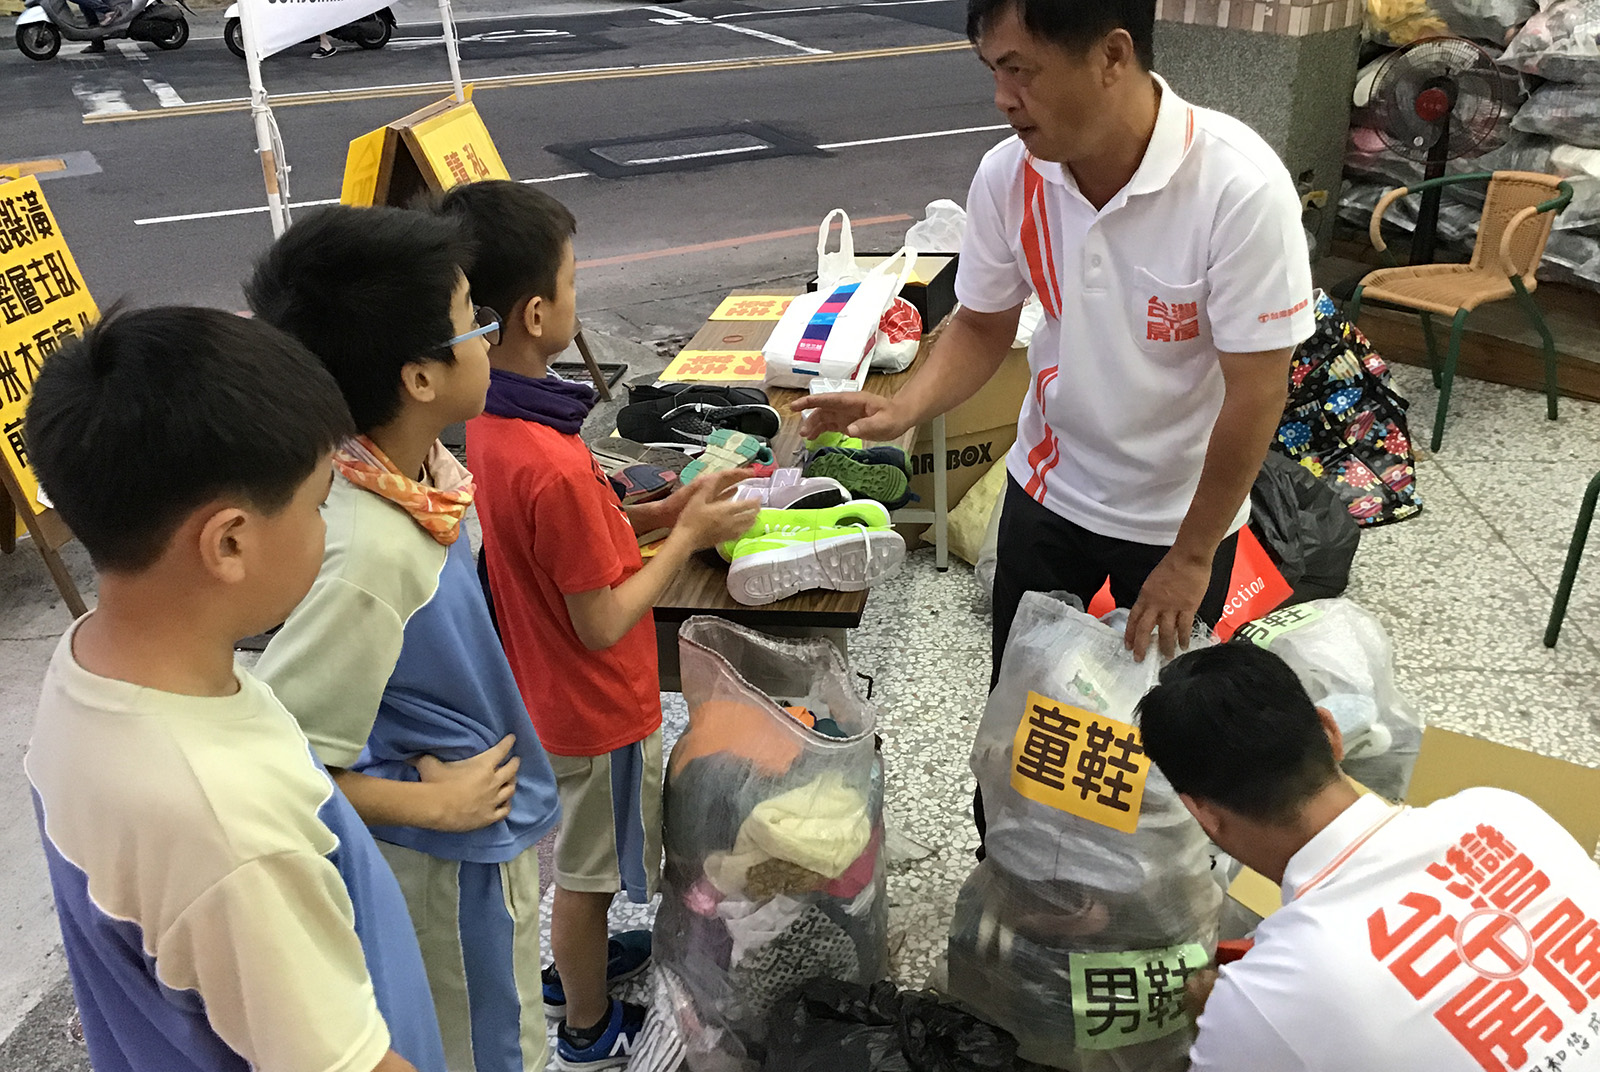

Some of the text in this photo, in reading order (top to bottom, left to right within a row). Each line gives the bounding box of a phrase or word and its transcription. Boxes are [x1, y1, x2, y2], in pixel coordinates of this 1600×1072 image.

[947, 441, 992, 470] BOX
[1016, 704, 1144, 812] 童鞋
[1084, 958, 1196, 1036] 男鞋
